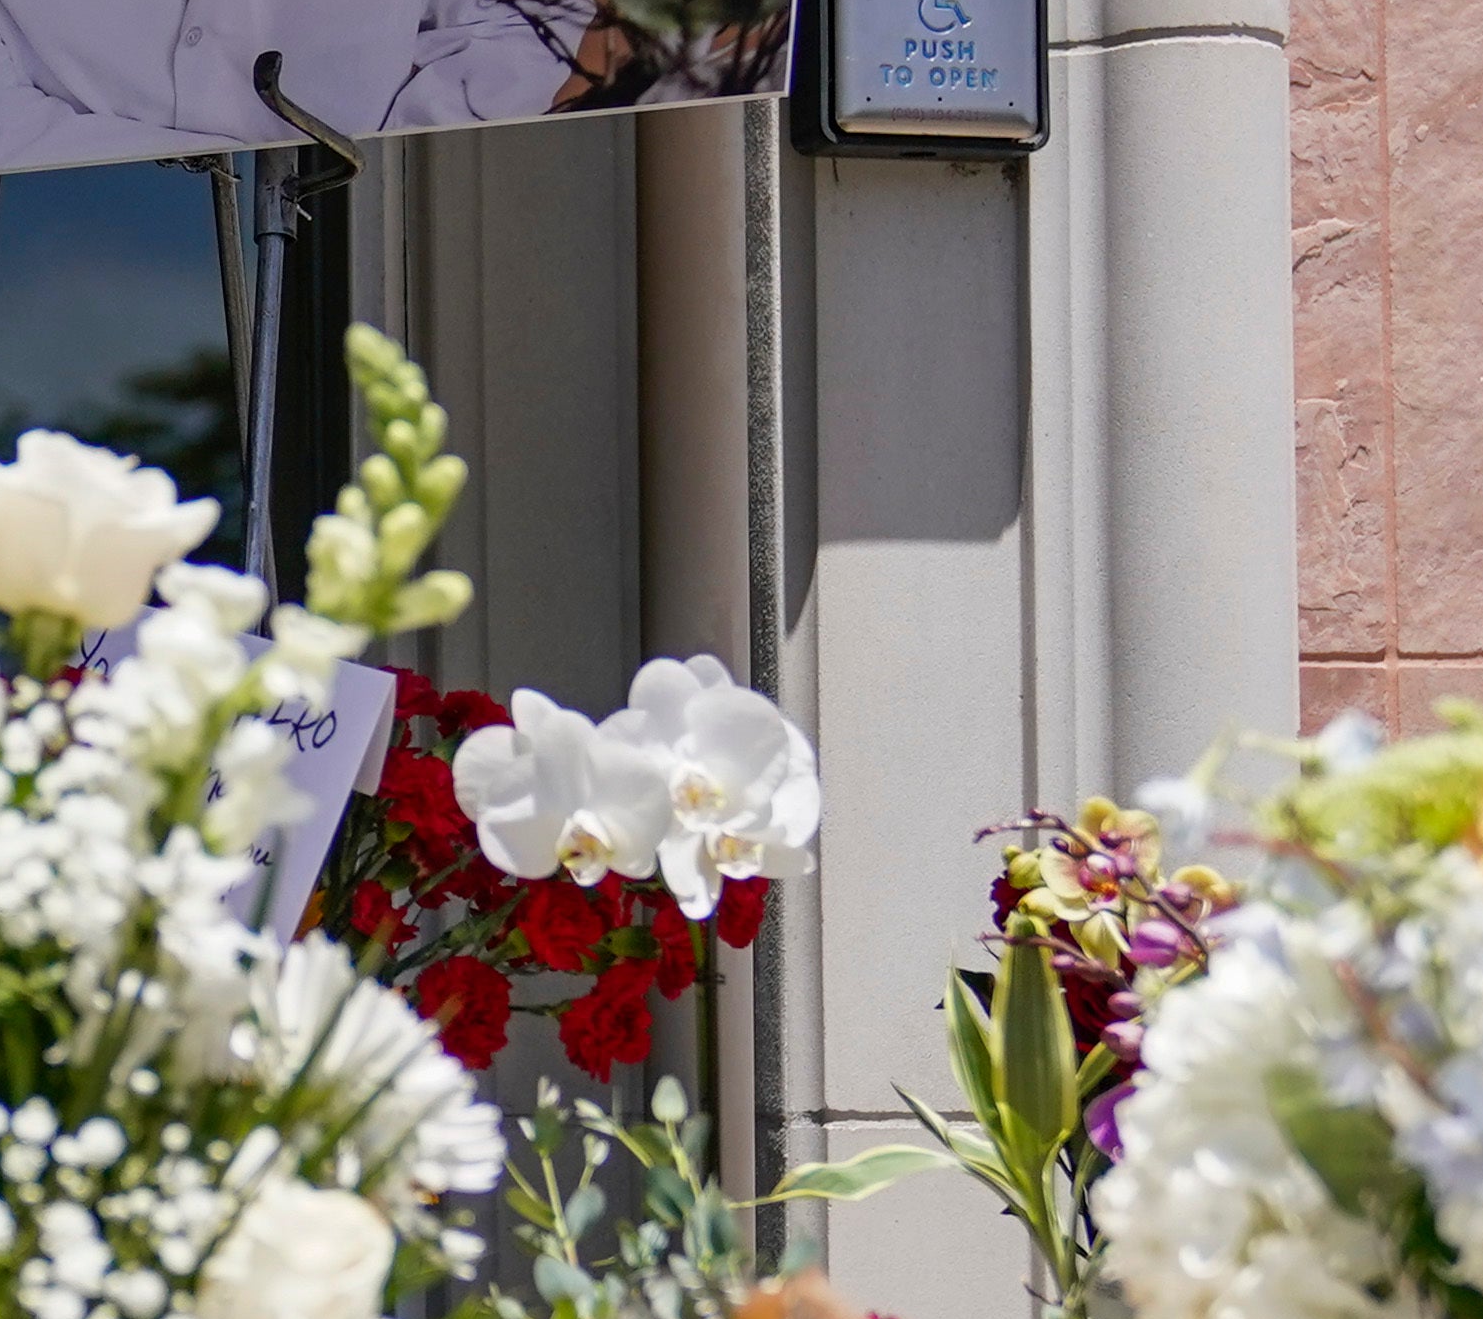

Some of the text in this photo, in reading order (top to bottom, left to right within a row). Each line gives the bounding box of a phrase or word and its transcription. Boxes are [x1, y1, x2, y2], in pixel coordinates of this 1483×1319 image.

[904, 38, 976, 61] PUSH
[879, 63, 999, 91] TO OPEN
